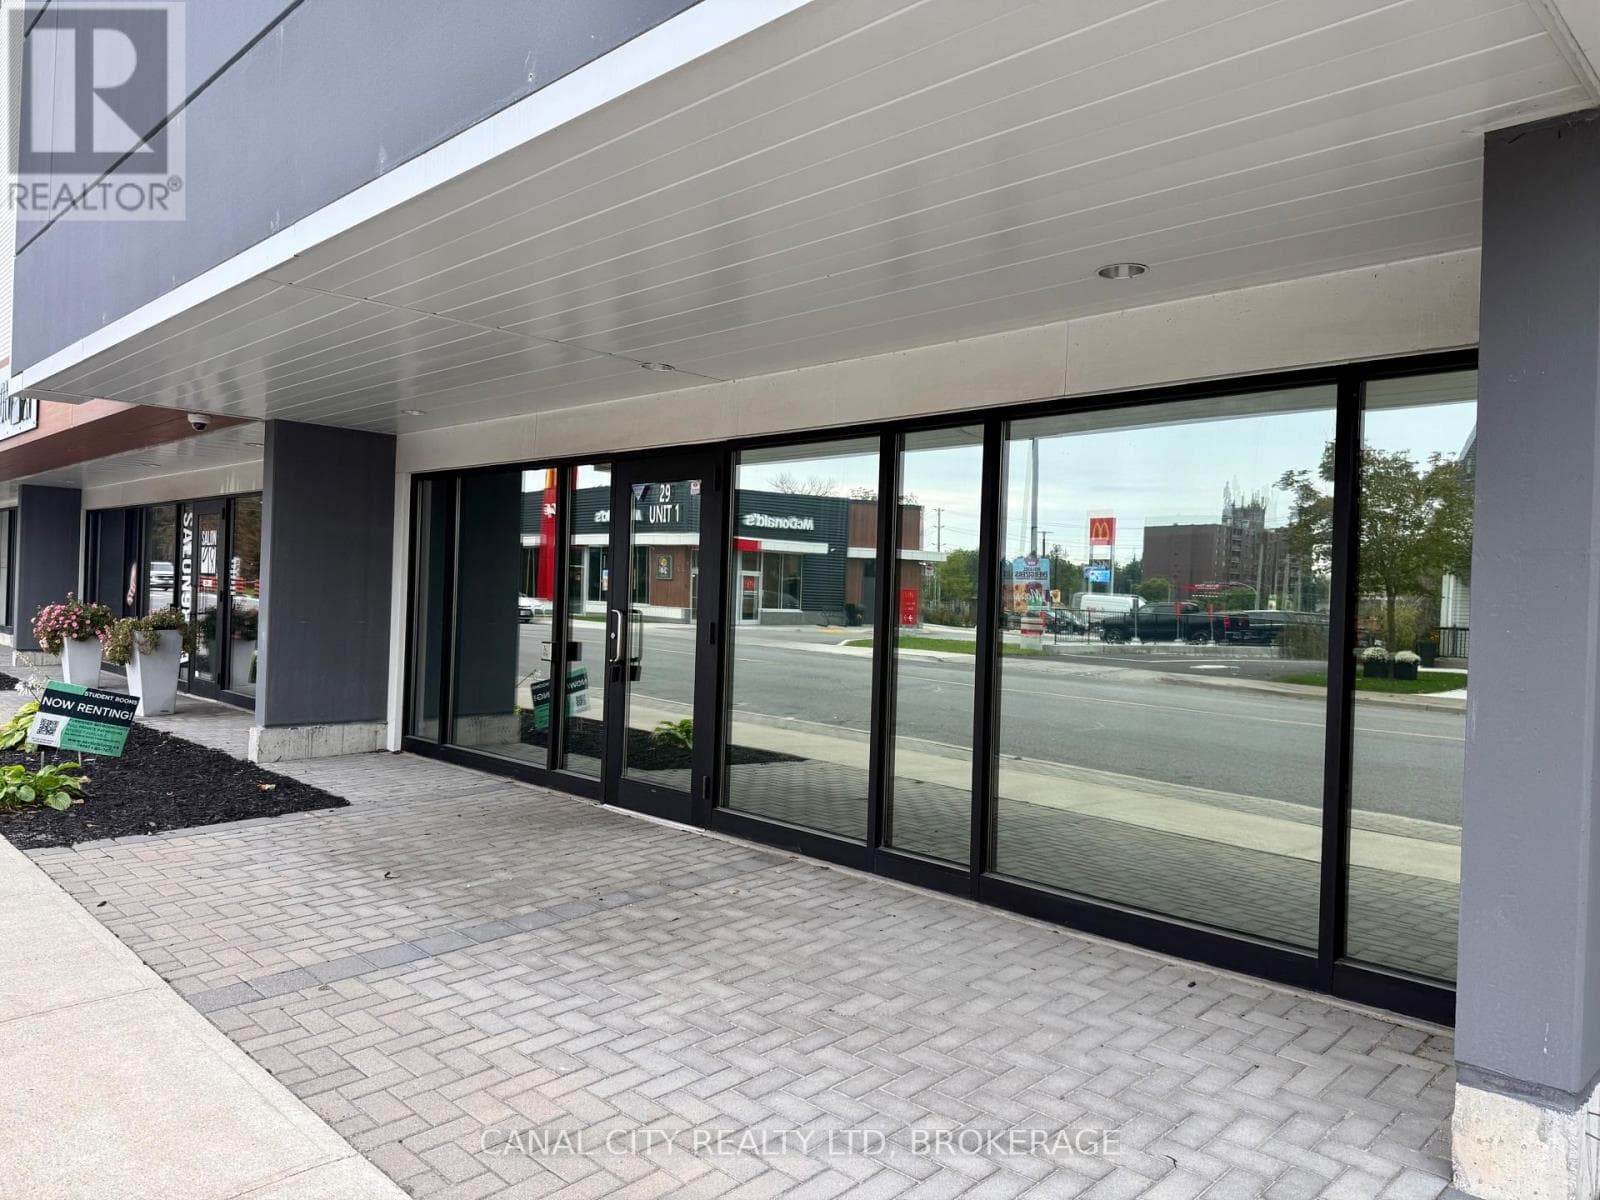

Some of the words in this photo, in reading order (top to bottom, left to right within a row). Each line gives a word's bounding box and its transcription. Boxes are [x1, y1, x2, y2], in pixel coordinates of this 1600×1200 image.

[659, 483, 671, 503] 29
[649, 504, 673, 524] UNIT
[674, 503, 680, 523] 1
[84, 690, 114, 701] STUDENT
[114, 696, 138, 706] ROOMS
[42, 696, 75, 710] NOW
[77, 702, 134, 721] RENTING!
